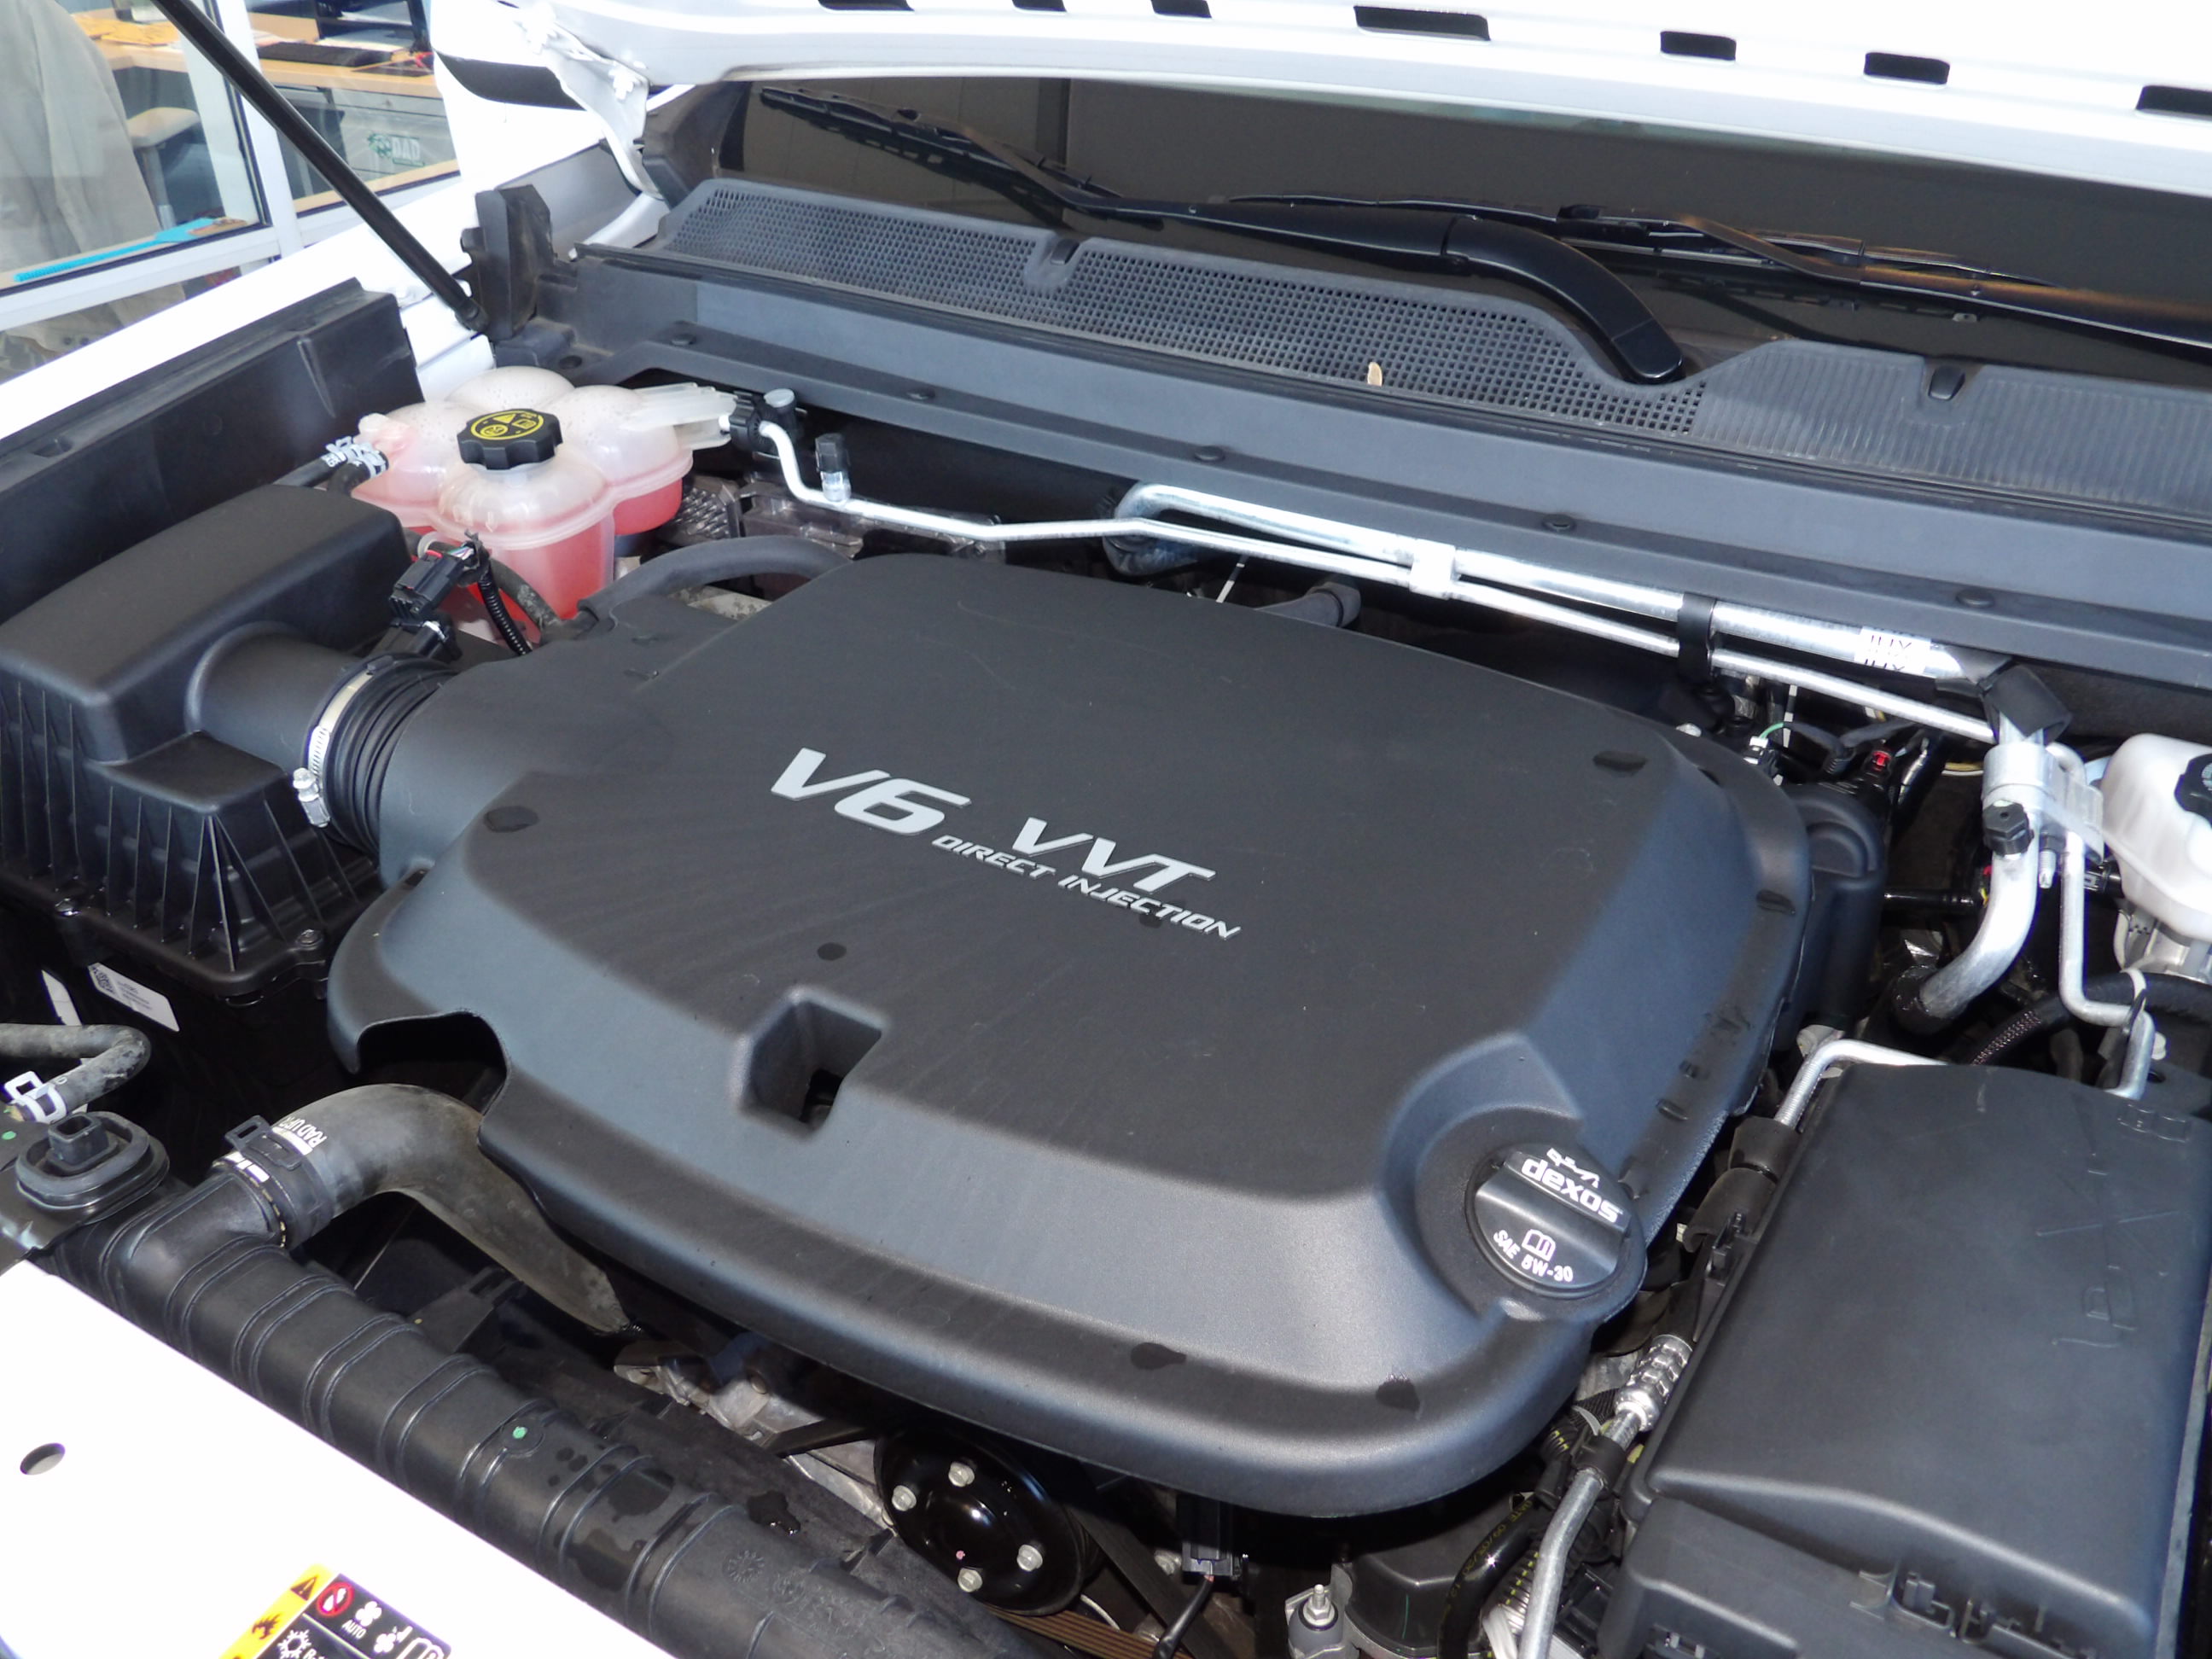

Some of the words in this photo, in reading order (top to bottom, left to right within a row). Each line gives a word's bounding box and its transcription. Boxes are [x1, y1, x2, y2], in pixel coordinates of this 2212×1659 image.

[771, 747, 972, 835] V6
[1012, 817, 1217, 894] VVT
[931, 834, 1057, 880] DIRECT
[1057, 875, 1242, 940] INJECTION
[297, 1123, 328, 1149] RAD
[1521, 1158, 1623, 1223] dexos
[1493, 1230, 1521, 1260] SAE
[1521, 1254, 1574, 1283] 5W-30
[341, 1620, 367, 1639] AUTO
